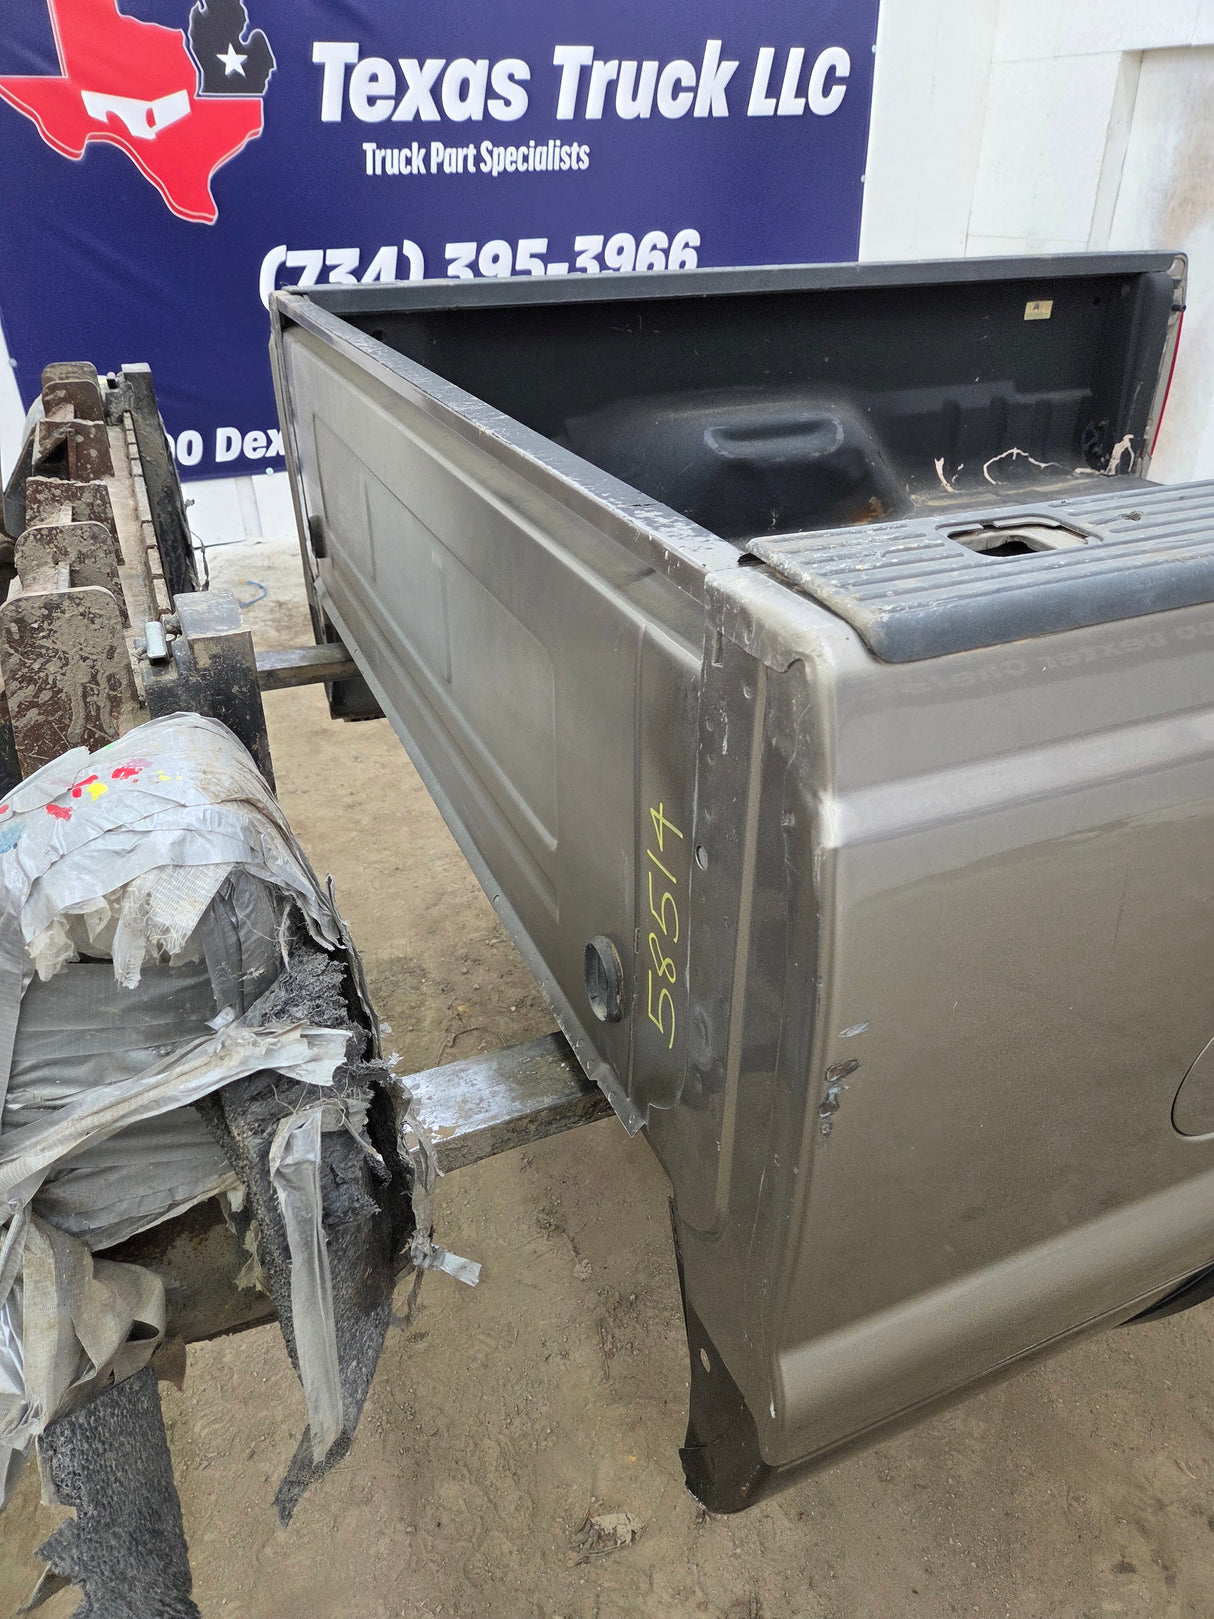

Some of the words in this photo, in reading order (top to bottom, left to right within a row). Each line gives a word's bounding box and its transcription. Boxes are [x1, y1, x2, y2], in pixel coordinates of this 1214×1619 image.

[311, 41, 531, 123] Texas
[552, 39, 740, 121] Truck
[746, 46, 851, 117] LLC
[362, 141, 427, 176] Truck
[430, 141, 477, 174] Part
[479, 139, 590, 177] Specialists
[444, 228, 701, 280] 395-3966
[646, 802, 684, 1050] 58514
